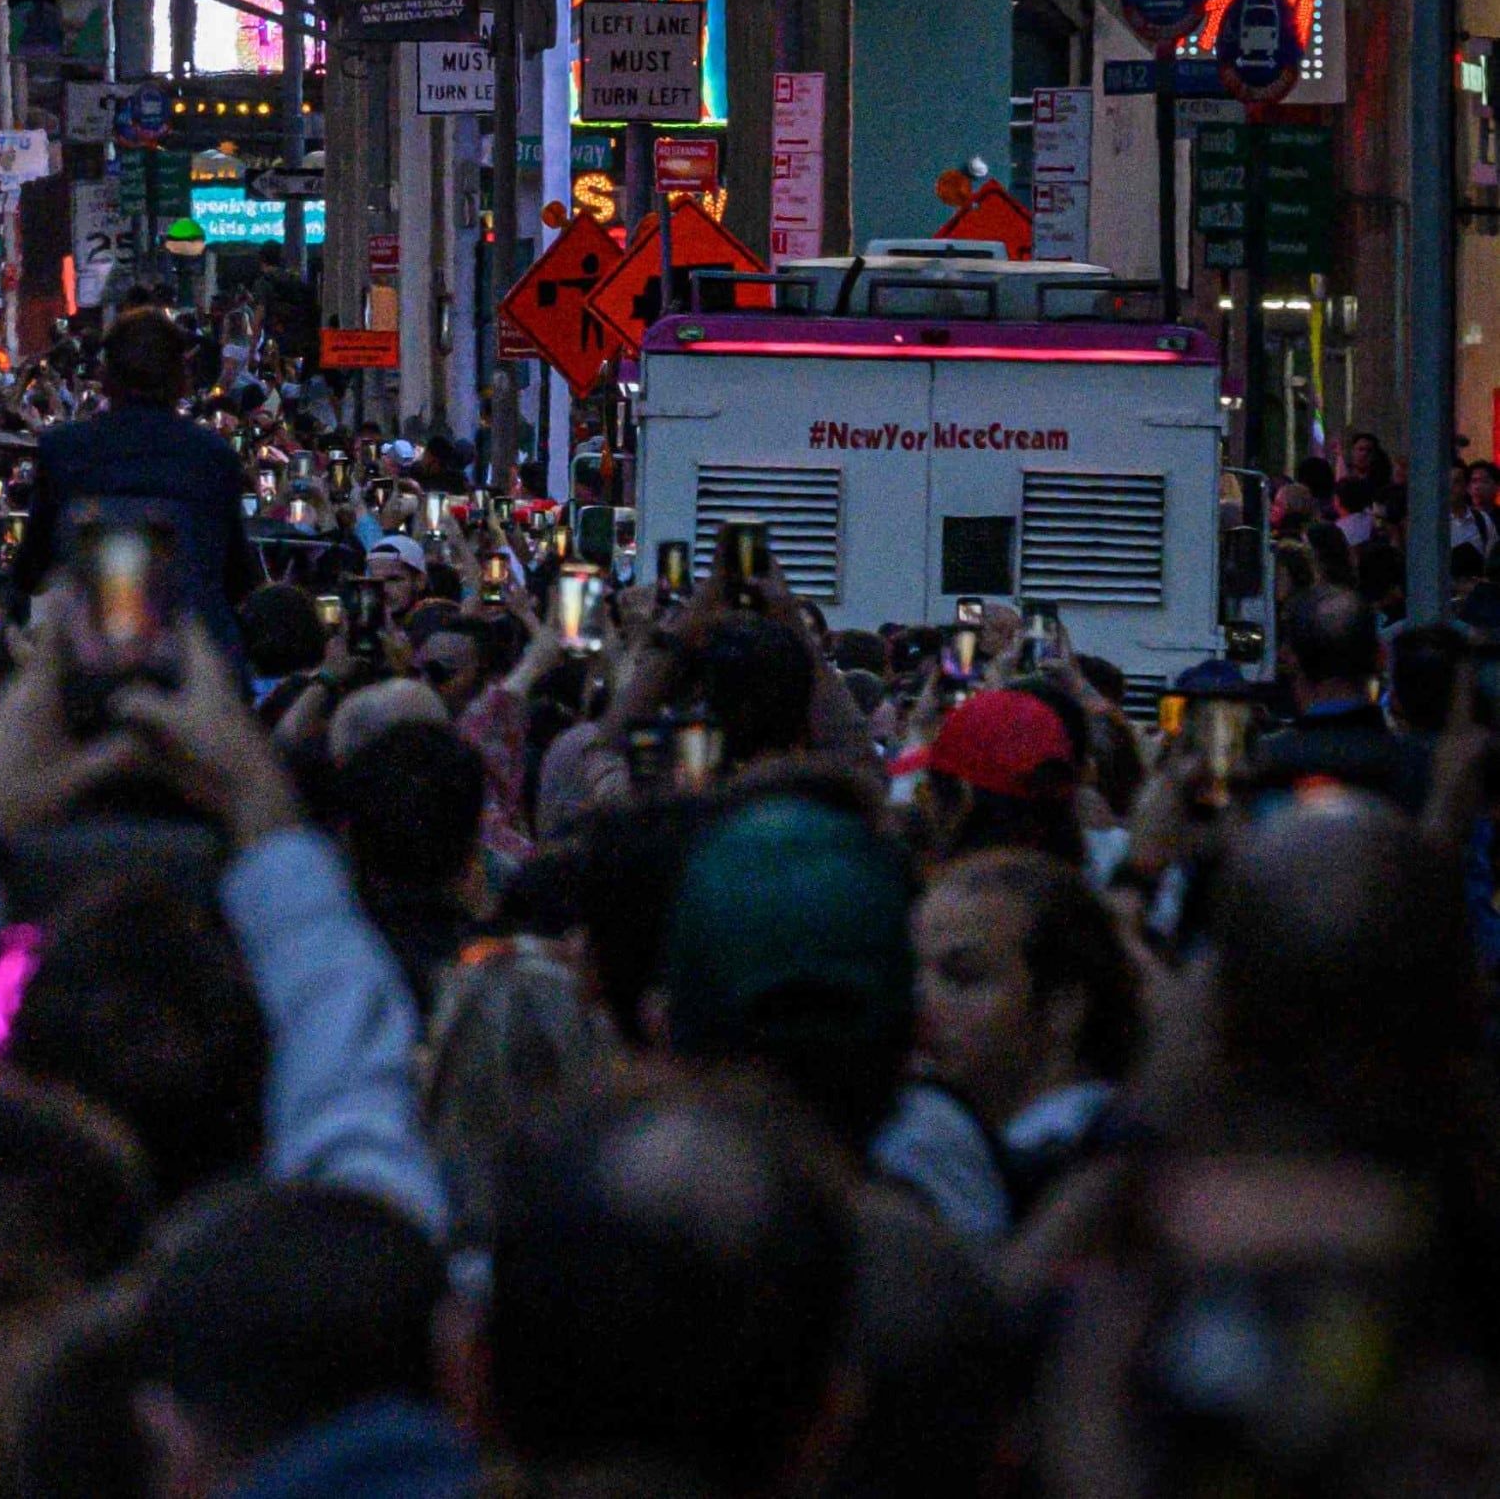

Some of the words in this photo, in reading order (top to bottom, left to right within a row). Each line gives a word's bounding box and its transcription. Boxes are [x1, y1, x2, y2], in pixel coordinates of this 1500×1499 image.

[591, 15, 633, 35] LEFT
[645, 15, 692, 36] LANE
[610, 50, 672, 73] MUST
[426, 84, 466, 101] TURN
[474, 84, 495, 101] LE
[591, 87, 638, 107] TURN
[648, 86, 692, 106] LEFT
